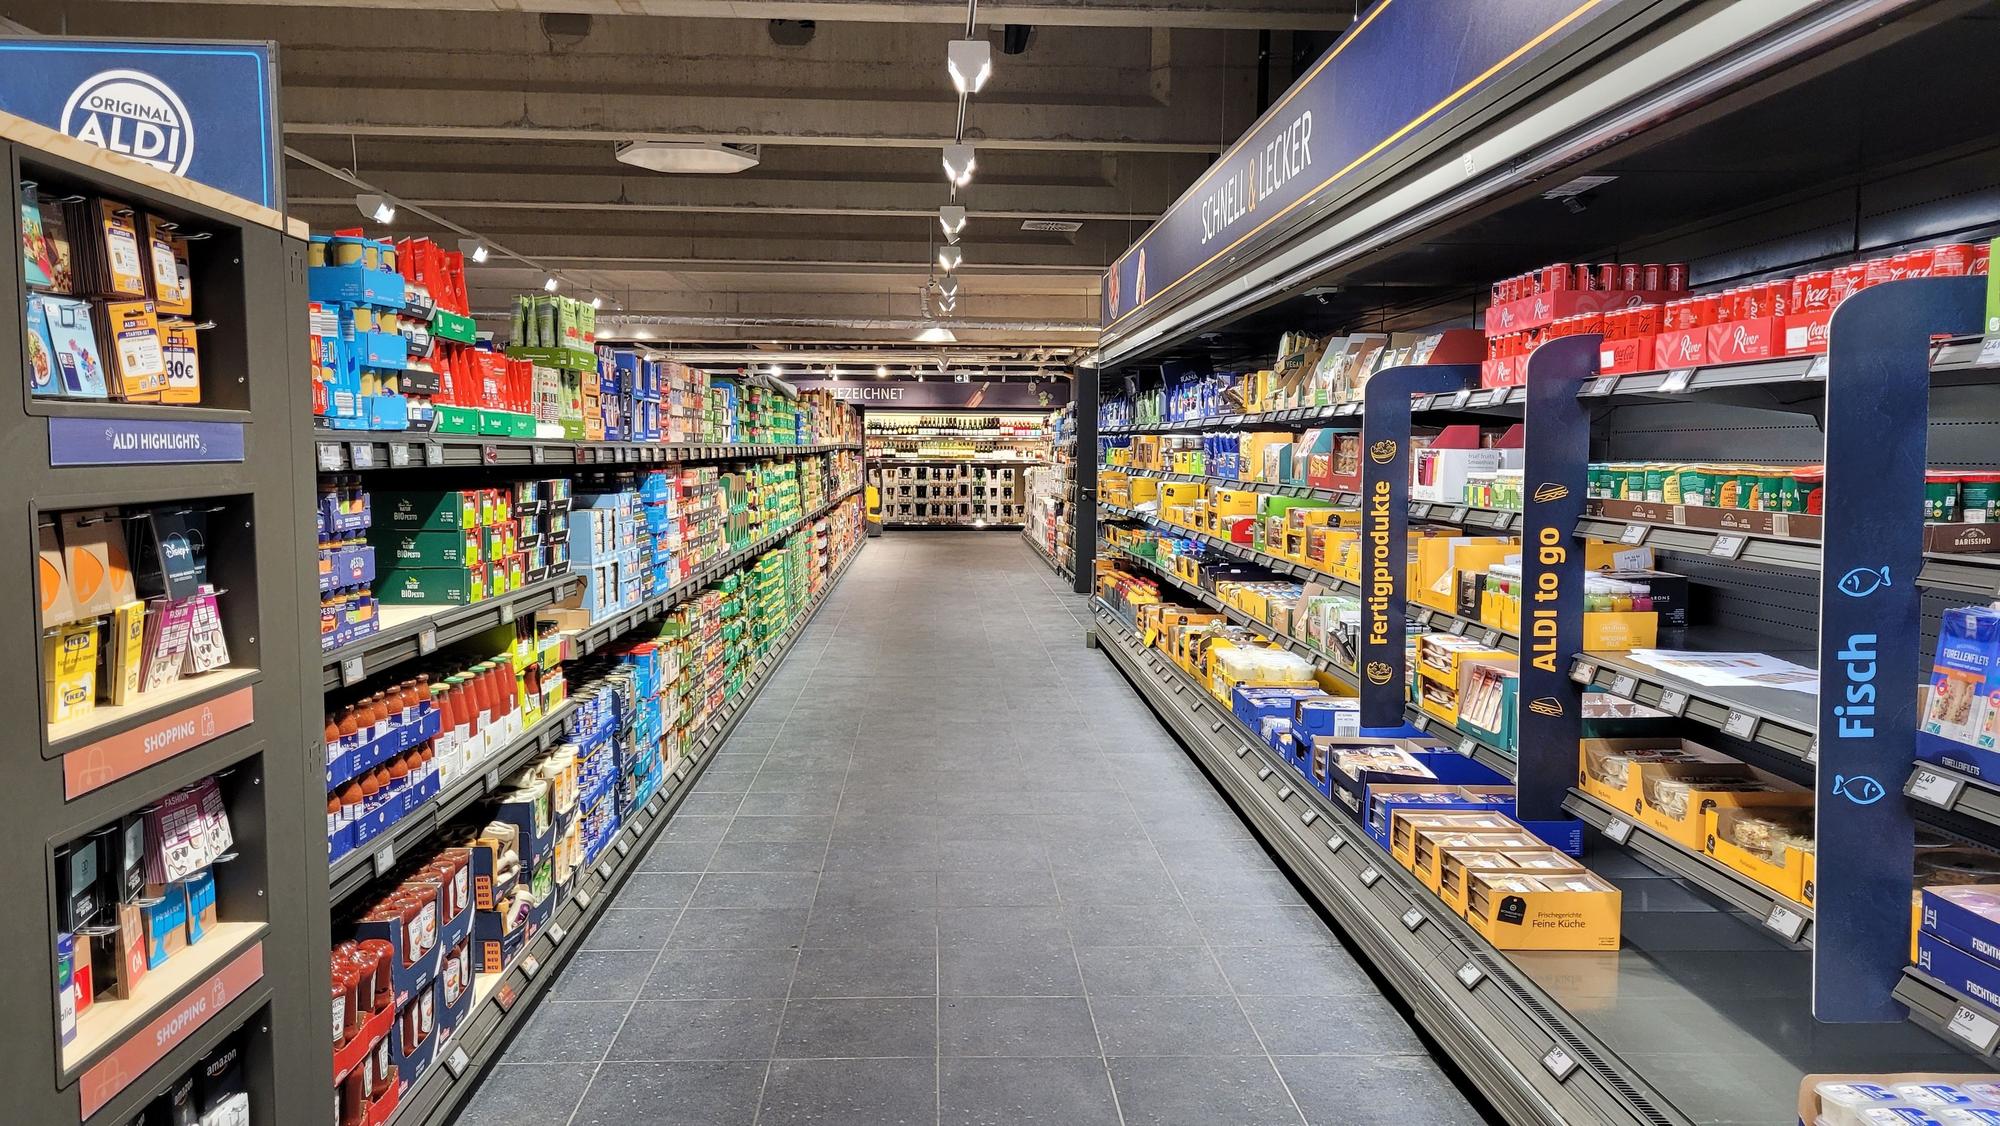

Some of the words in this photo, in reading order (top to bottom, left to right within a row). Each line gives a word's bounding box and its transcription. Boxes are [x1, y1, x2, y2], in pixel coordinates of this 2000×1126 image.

[90, 96, 171, 122] ORIGINAL
[76, 112, 179, 162] ALDI
[1201, 169, 1246, 244] SCHNELL
[1248, 158, 1256, 212] &
[1259, 110, 1312, 201] LECKER
[1501, 307, 1515, 328] River
[1533, 298, 1550, 320] River
[124, 321, 136, 329] ALDI
[1679, 335, 1702, 360] River
[1731, 325, 1759, 354] River
[166, 360, 194, 380] 30€
[1180, 374, 1199, 382] RANA
[831, 387, 905, 400] GEZEICHNET
[113, 433, 138, 450] ALDI
[141, 431, 200, 452] HIGHLIGHTS
[163, 543, 189, 560] Disney+
[1539, 527, 1566, 563] go
[1955, 537, 1991, 546] BARISSIMO
[1367, 480, 1393, 645] Fertigprodukte
[1535, 572, 1559, 602] to
[67, 637, 88, 647] IKEA
[1532, 610, 1557, 672] ALDI
[1943, 647, 1990, 667] FORELLENFILETS
[1833, 633, 1877, 739] Fisch
[66, 692, 85, 702] IKEA
[143, 720, 195, 753] SHOPPING
[1941, 756, 1981, 776] FORELLENFILETS
[1918, 772, 1937, 785] 2,49
[165, 792, 189, 807] FASHION
[1532, 920, 1556, 928] Feine
[1558, 919, 1586, 928] Küche
[1537, 912, 1582, 920] Frischegerichte
[156, 996, 206, 1046] SHOPPING
[1958, 1007, 1975, 1022] 1,99
[207, 1048, 237, 1077] amazon
